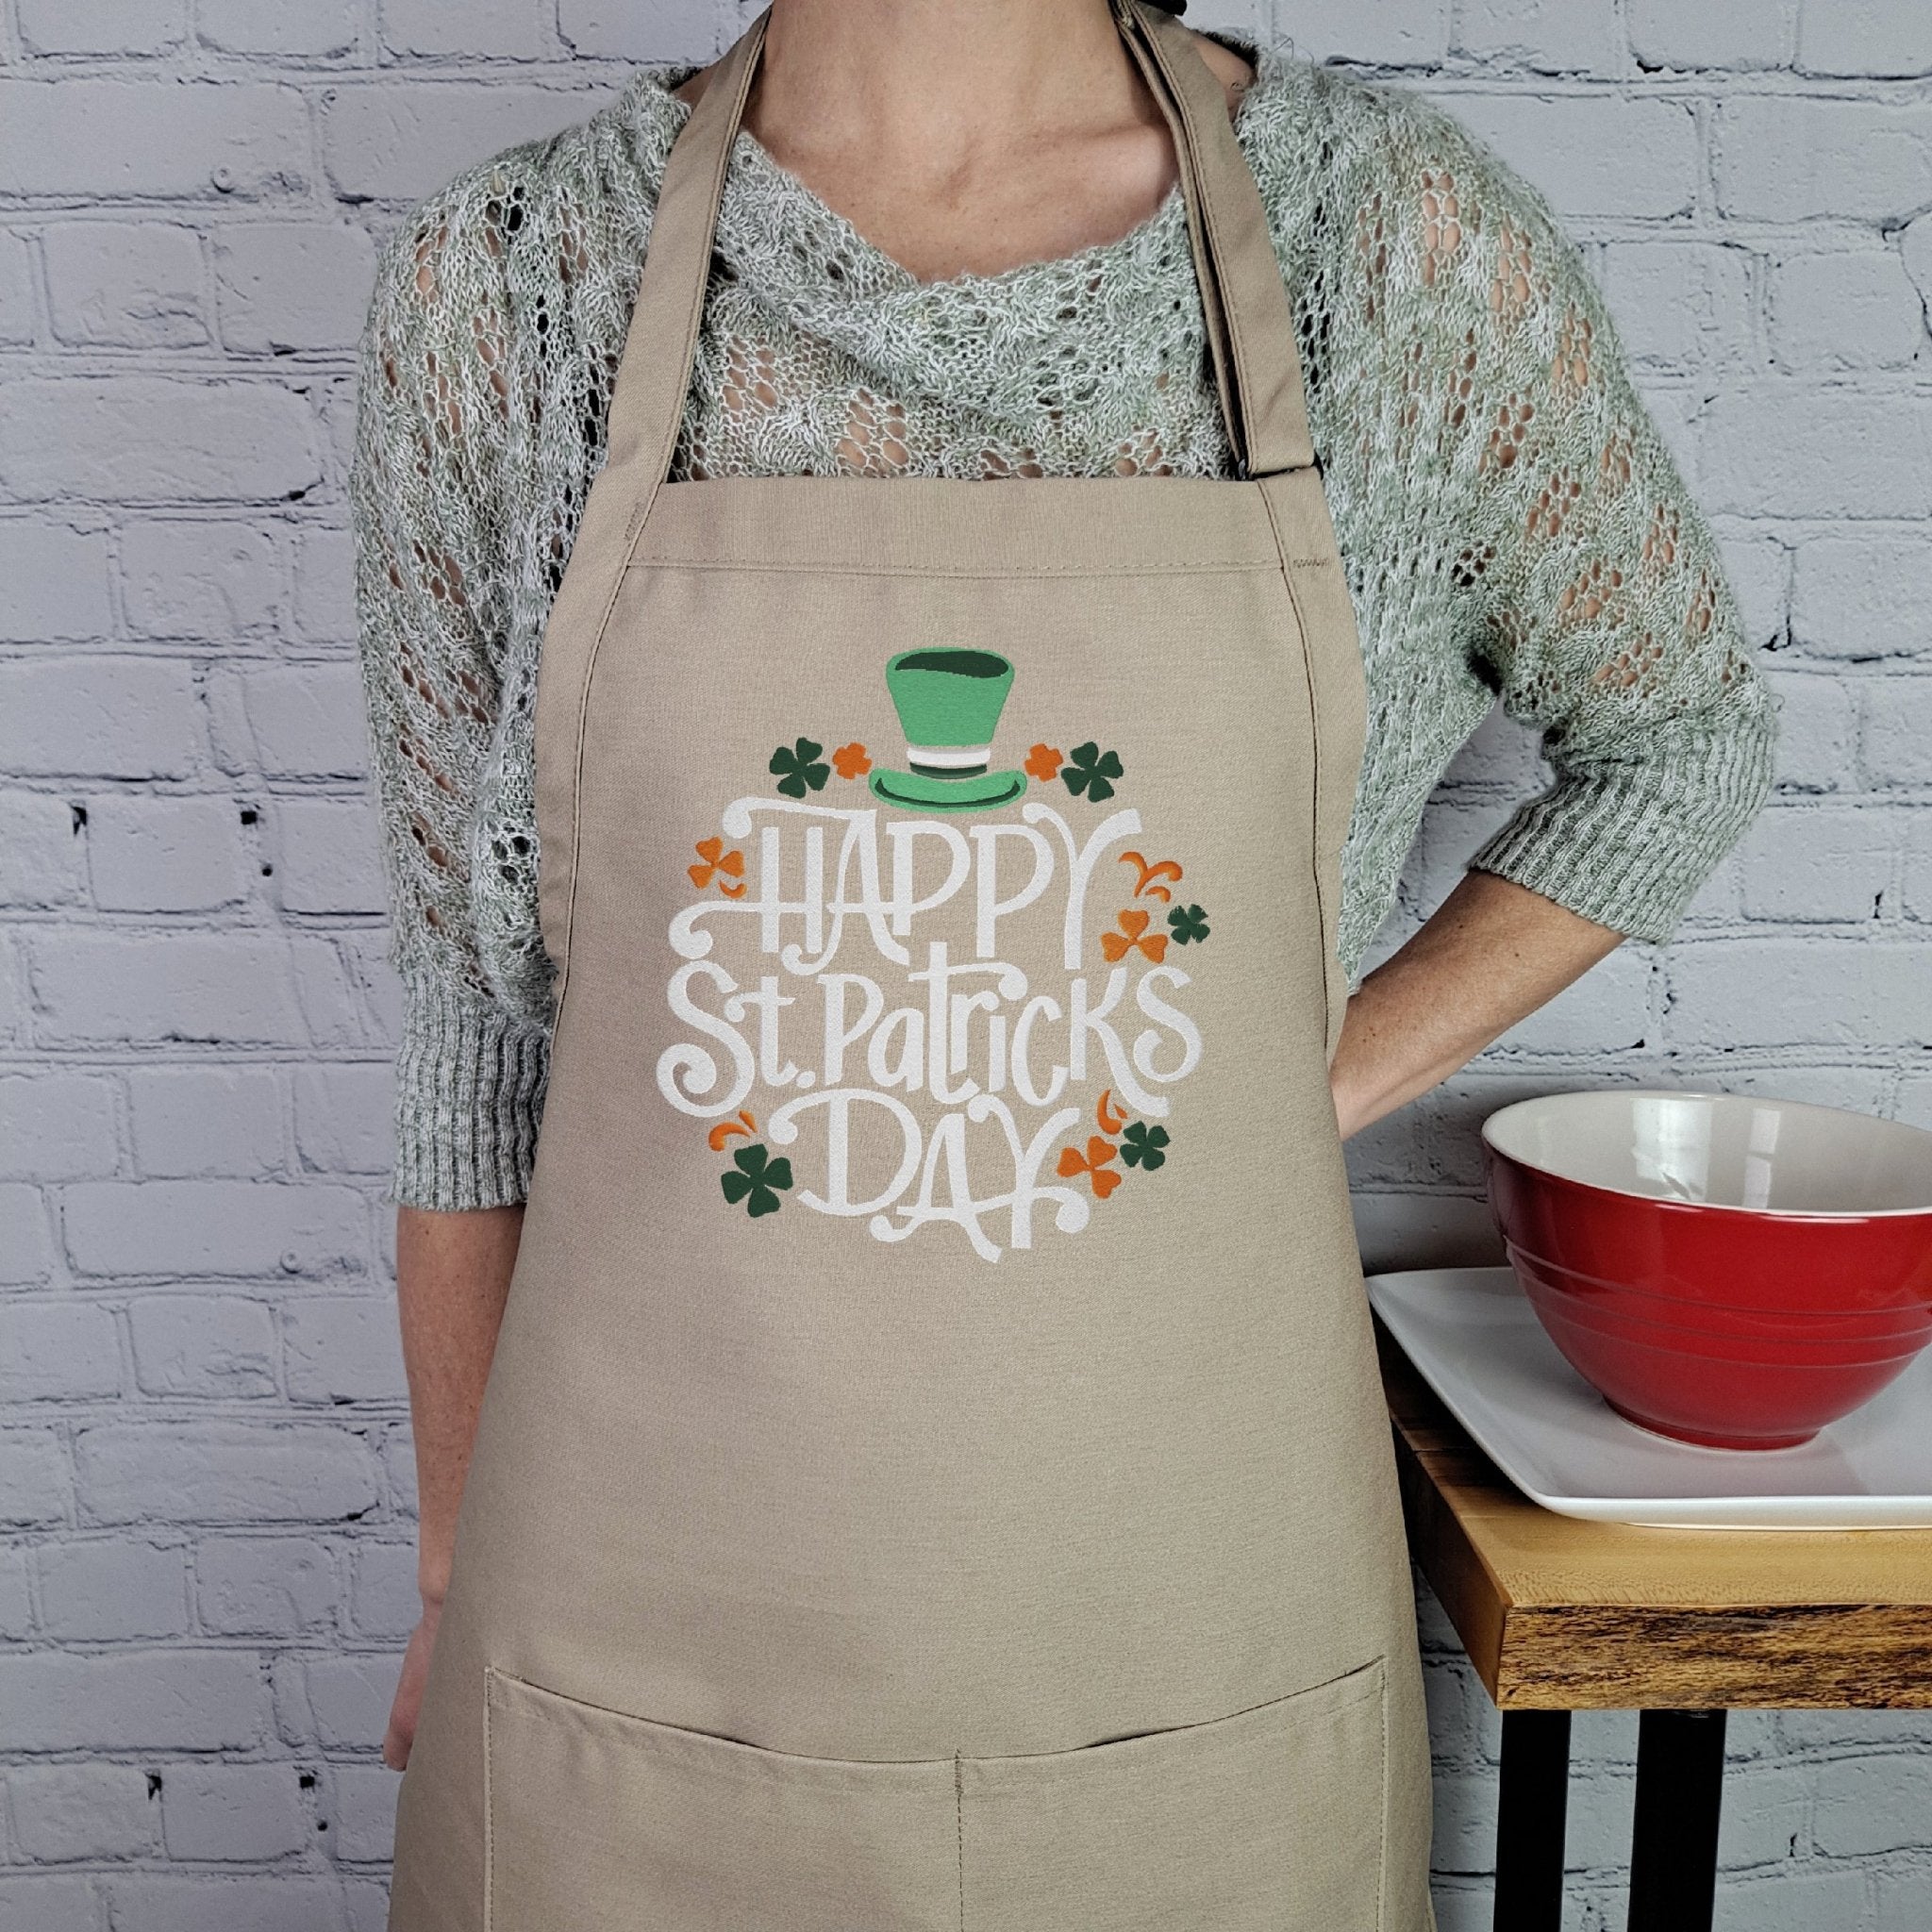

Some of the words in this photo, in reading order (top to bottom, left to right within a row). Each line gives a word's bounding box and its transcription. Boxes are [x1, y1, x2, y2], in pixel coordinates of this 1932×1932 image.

[668, 796, 1142, 975] HAPPY
[656, 959, 817, 1118] St.
[768, 1087, 1091, 1264] DAY
